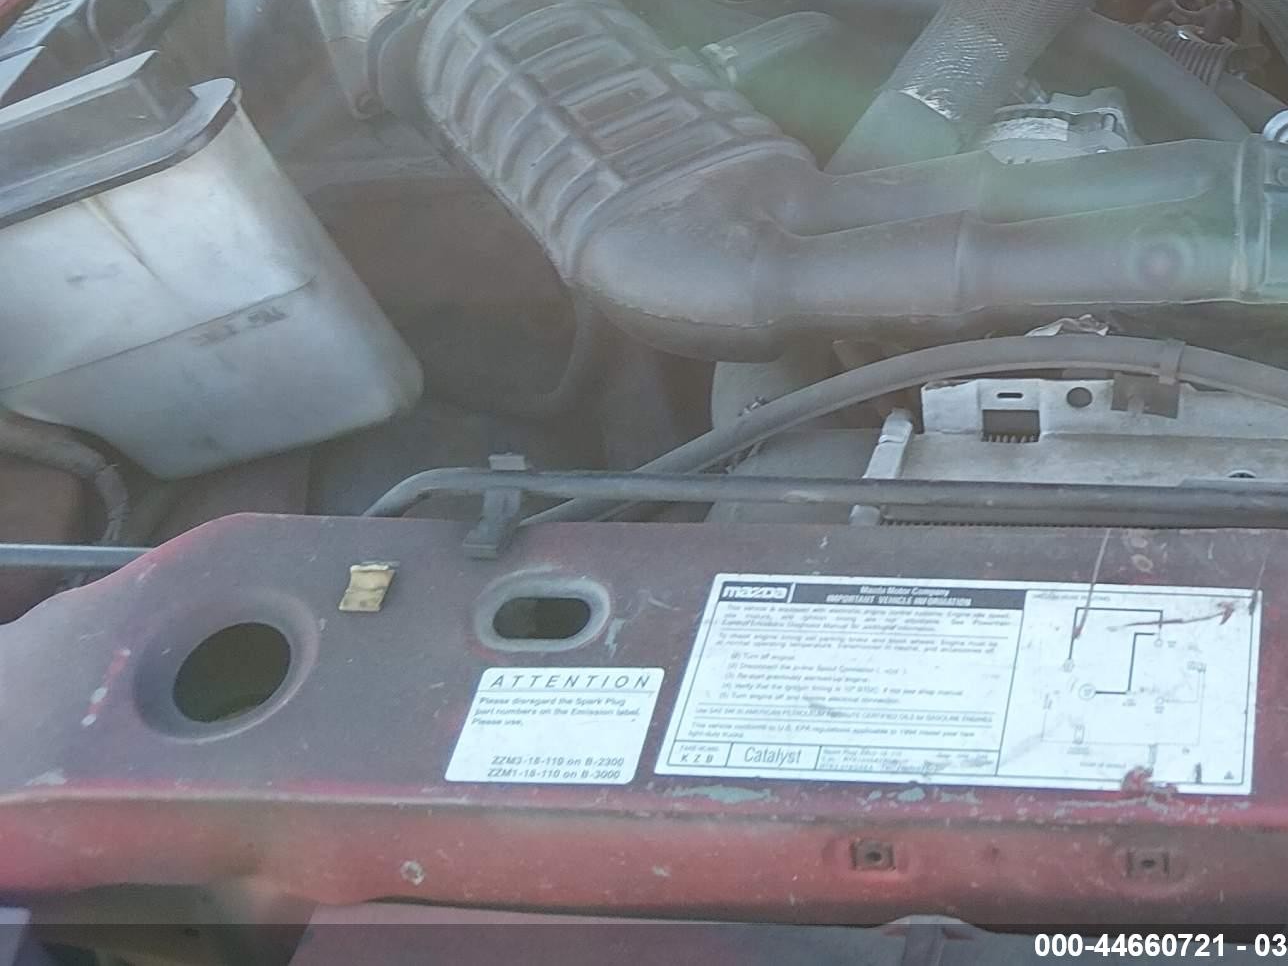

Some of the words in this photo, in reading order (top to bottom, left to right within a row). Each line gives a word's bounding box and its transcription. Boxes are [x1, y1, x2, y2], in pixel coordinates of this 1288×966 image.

[722, 586, 788, 599] mazda
[490, 675, 651, 688] ATTENTION
[744, 746, 803, 770] Catalyst
